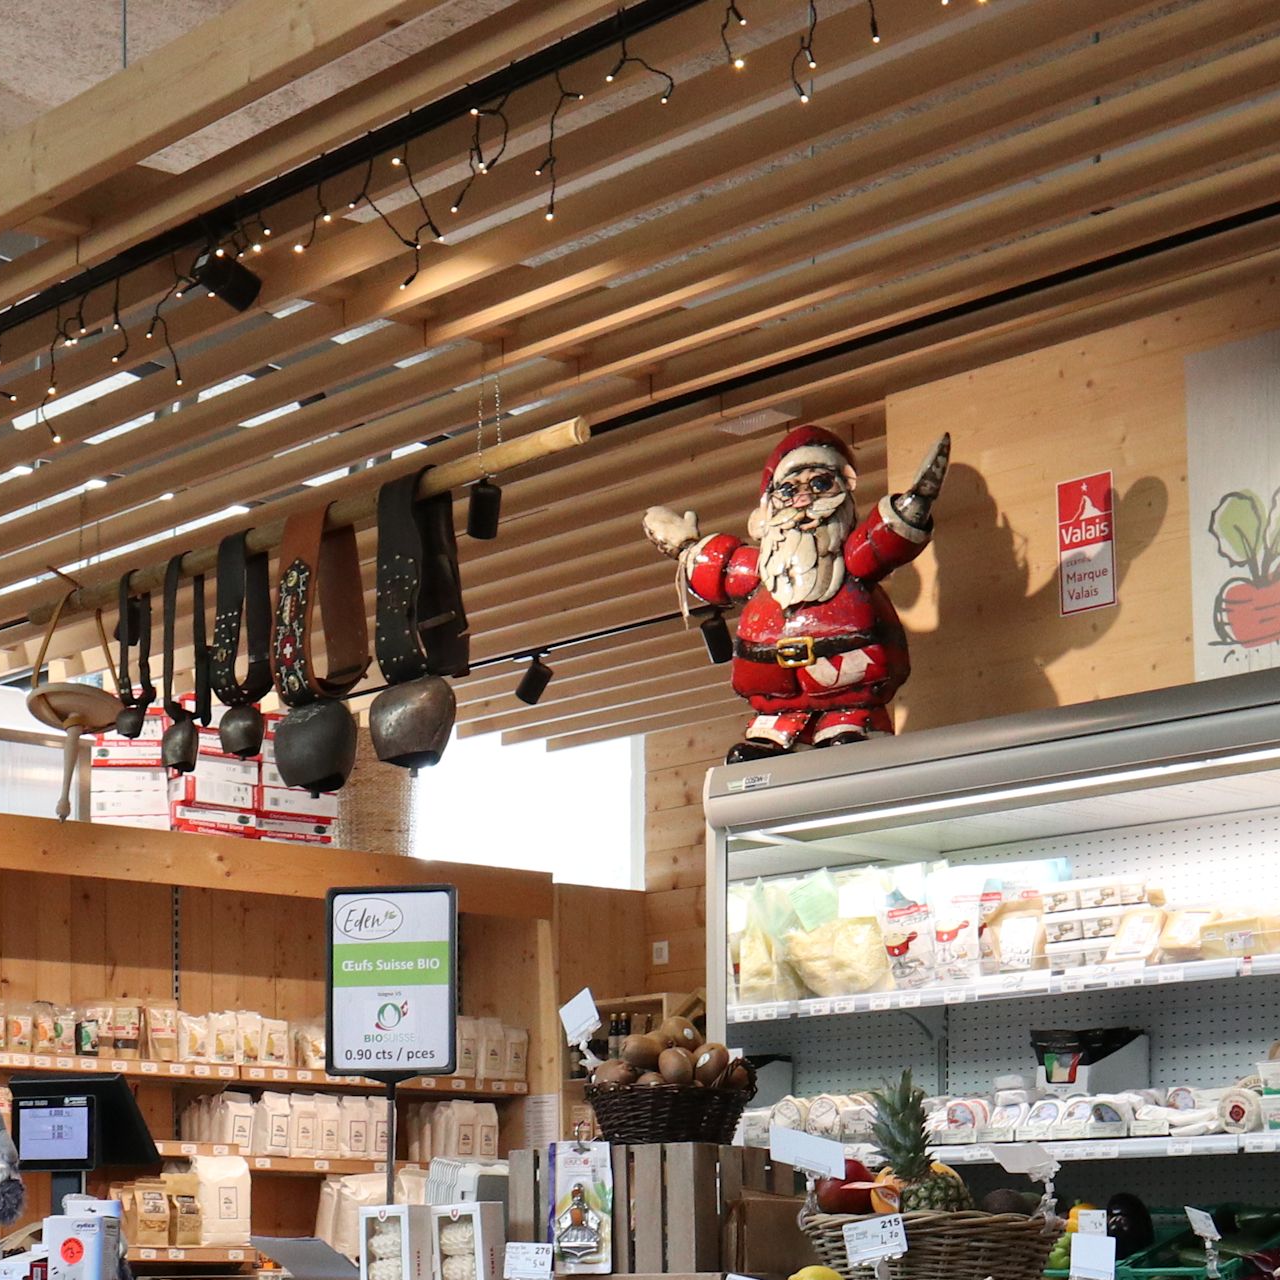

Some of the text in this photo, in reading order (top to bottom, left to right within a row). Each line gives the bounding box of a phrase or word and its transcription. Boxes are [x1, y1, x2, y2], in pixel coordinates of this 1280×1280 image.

[1061, 518, 1110, 545] Valais
[1066, 565, 1109, 585] Marque
[1067, 585, 1099, 602] Valais
[343, 908, 388, 934] Eden
[341, 958, 440, 972] Œufs Suisse BIO
[345, 1047, 435, 1062] 0.90 cts / pces
[880, 1218, 900, 1229] 215
[535, 1246, 551, 1255] 276
